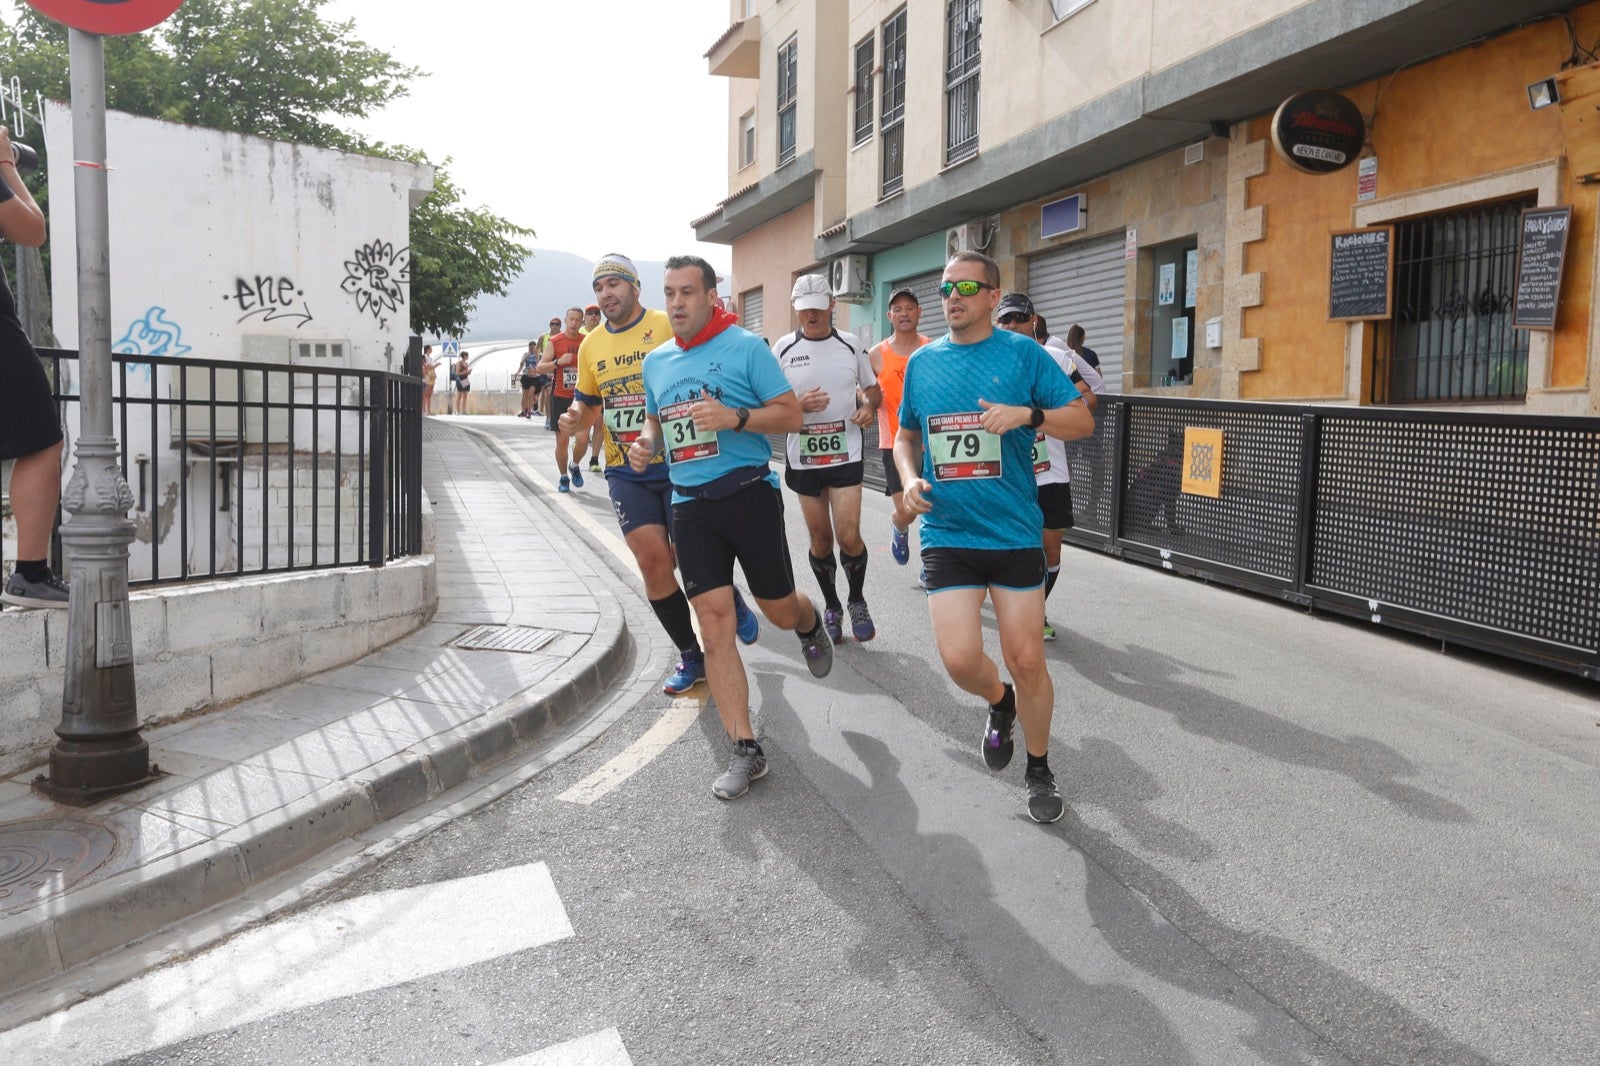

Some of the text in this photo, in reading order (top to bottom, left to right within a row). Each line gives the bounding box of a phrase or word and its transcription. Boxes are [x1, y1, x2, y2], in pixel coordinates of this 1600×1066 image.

[1335, 232, 1386, 248] RACIONES
[614, 350, 648, 366] Vigils
[614, 409, 646, 428] 174
[807, 435, 840, 453] 666
[947, 434, 980, 458] 79
